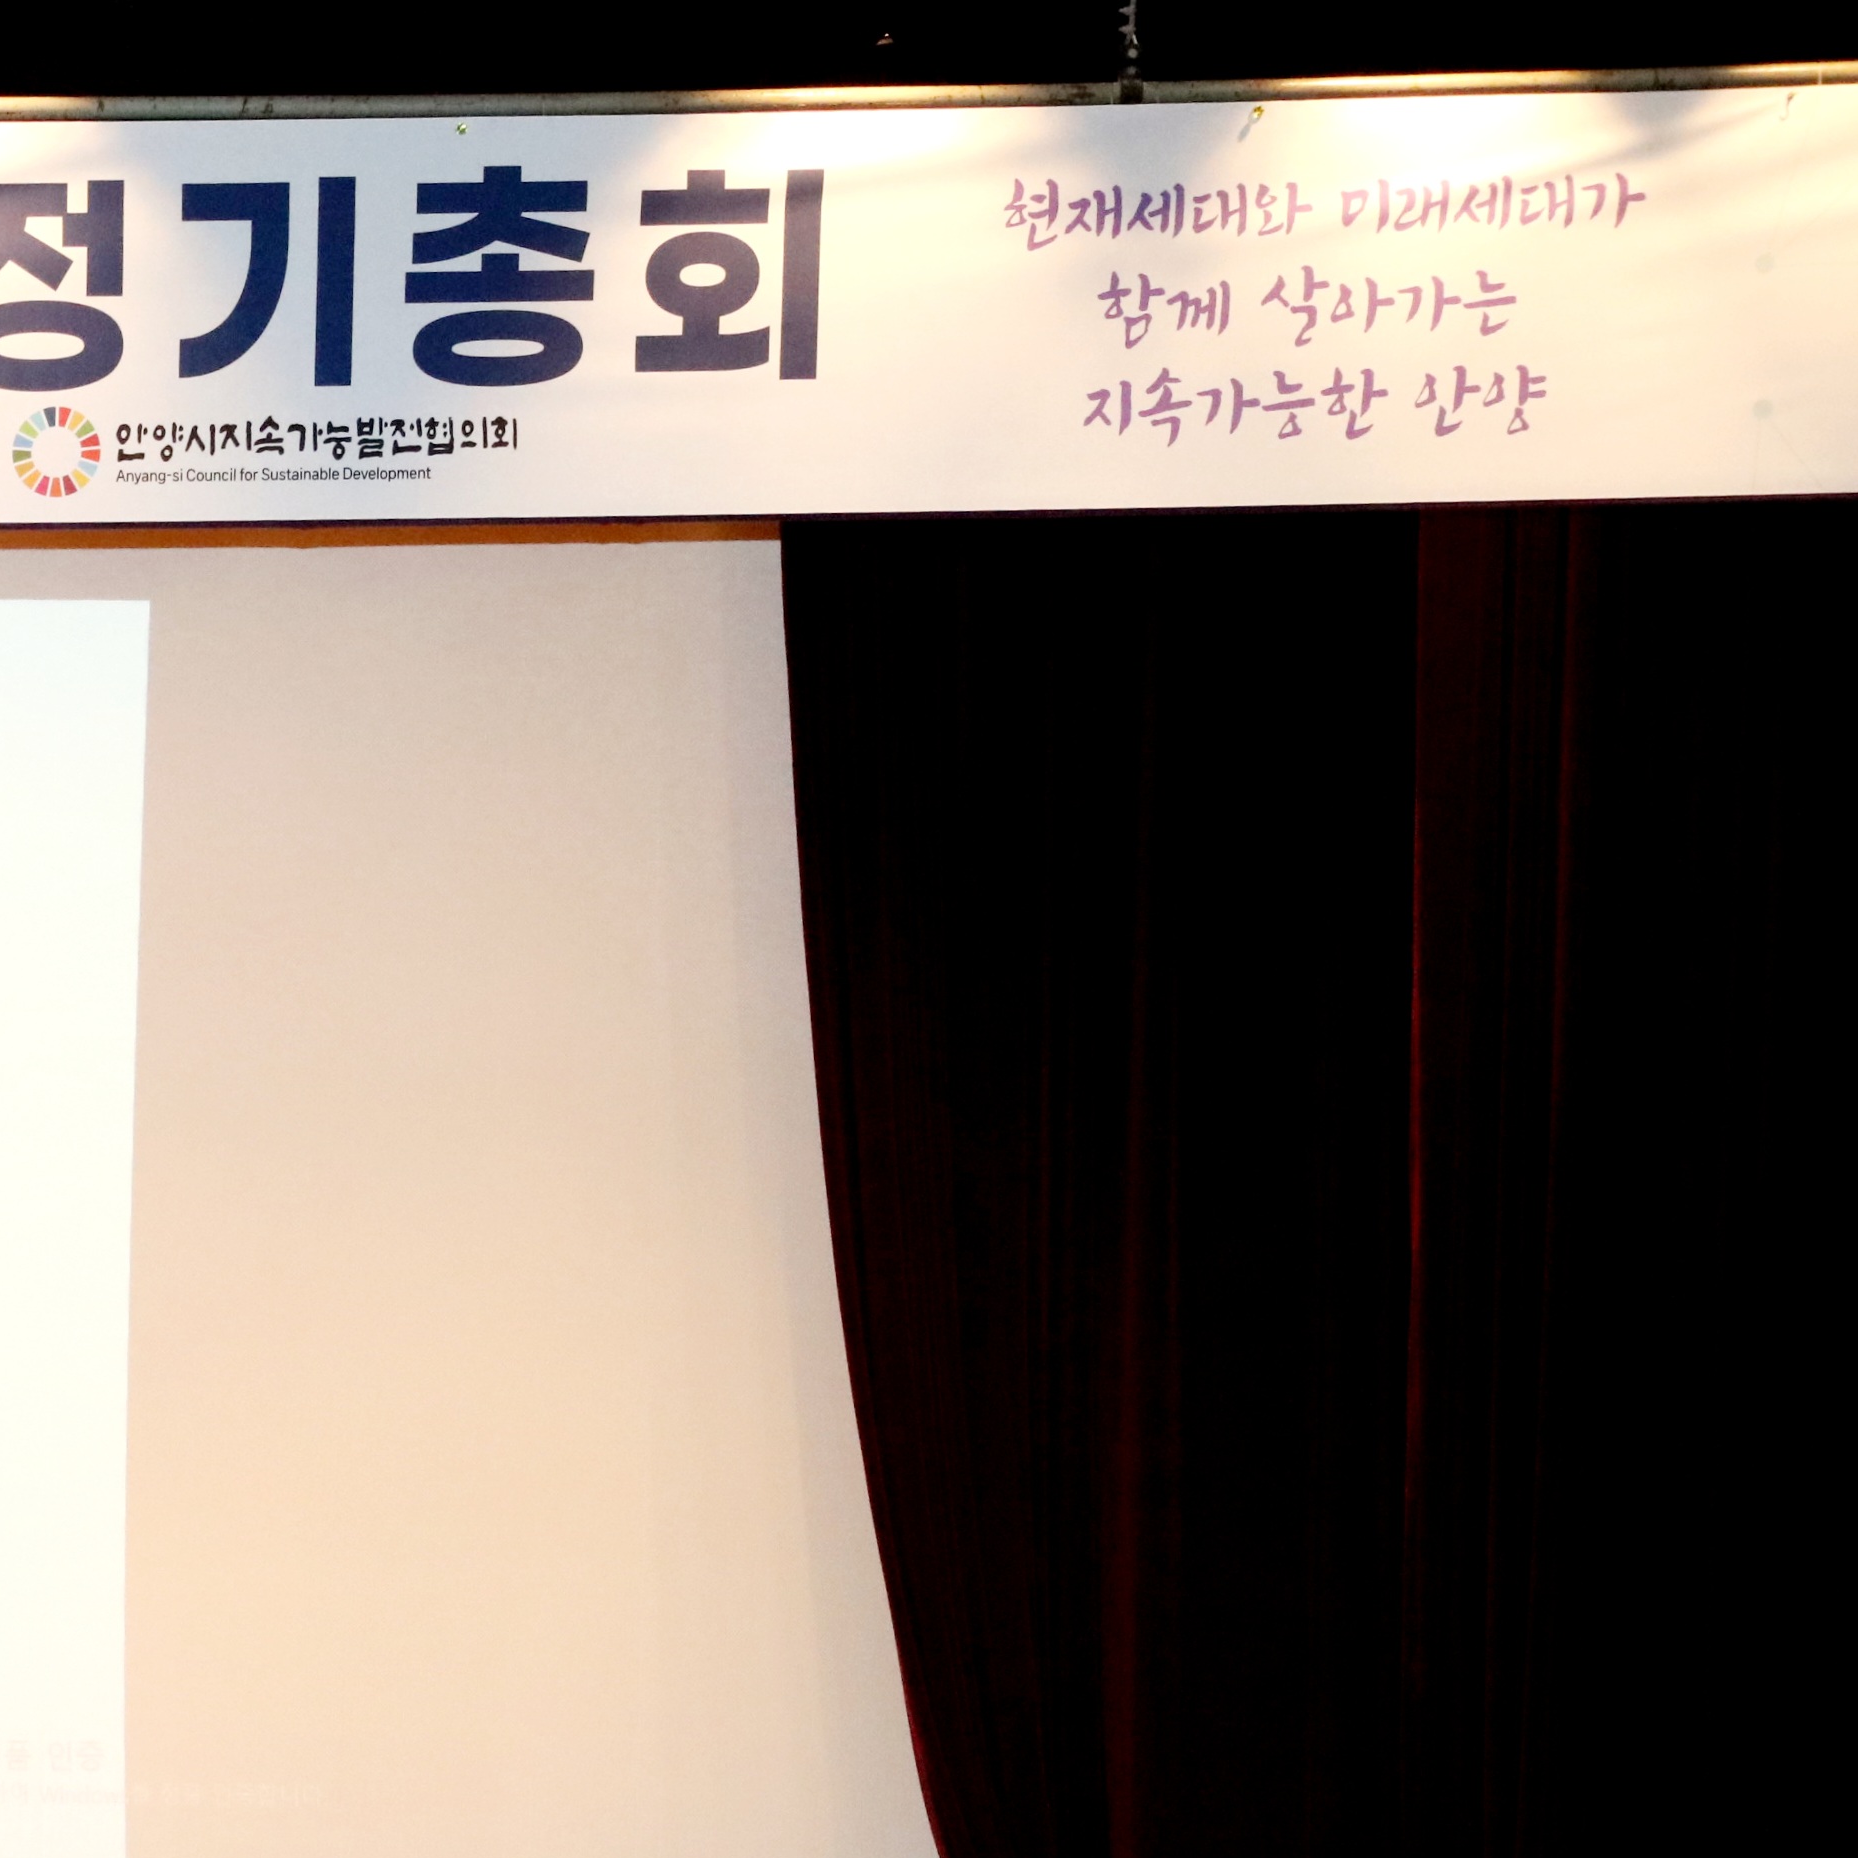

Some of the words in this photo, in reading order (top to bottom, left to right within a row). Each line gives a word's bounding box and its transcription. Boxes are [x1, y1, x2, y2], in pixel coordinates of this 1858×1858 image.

[1003, 178, 1313, 251] 현재세대와
[1341, 173, 1646, 235] 미래세대가
[1097, 270, 1231, 348] 함께
[1261, 265, 1517, 347] 살아가는
[1083, 367, 1388, 447] 지속가능한
[1414, 365, 1547, 436] 안양
[116, 416, 518, 461] 안양시지속가능발전협의회
[116, 468, 183, 486] Anyang-si
[187, 467, 237, 484] Council
[239, 467, 259, 484] for
[261, 467, 340, 483] Sustainable
[343, 467, 431, 485] Development
[47, 1739, 106, 1772] 인증
